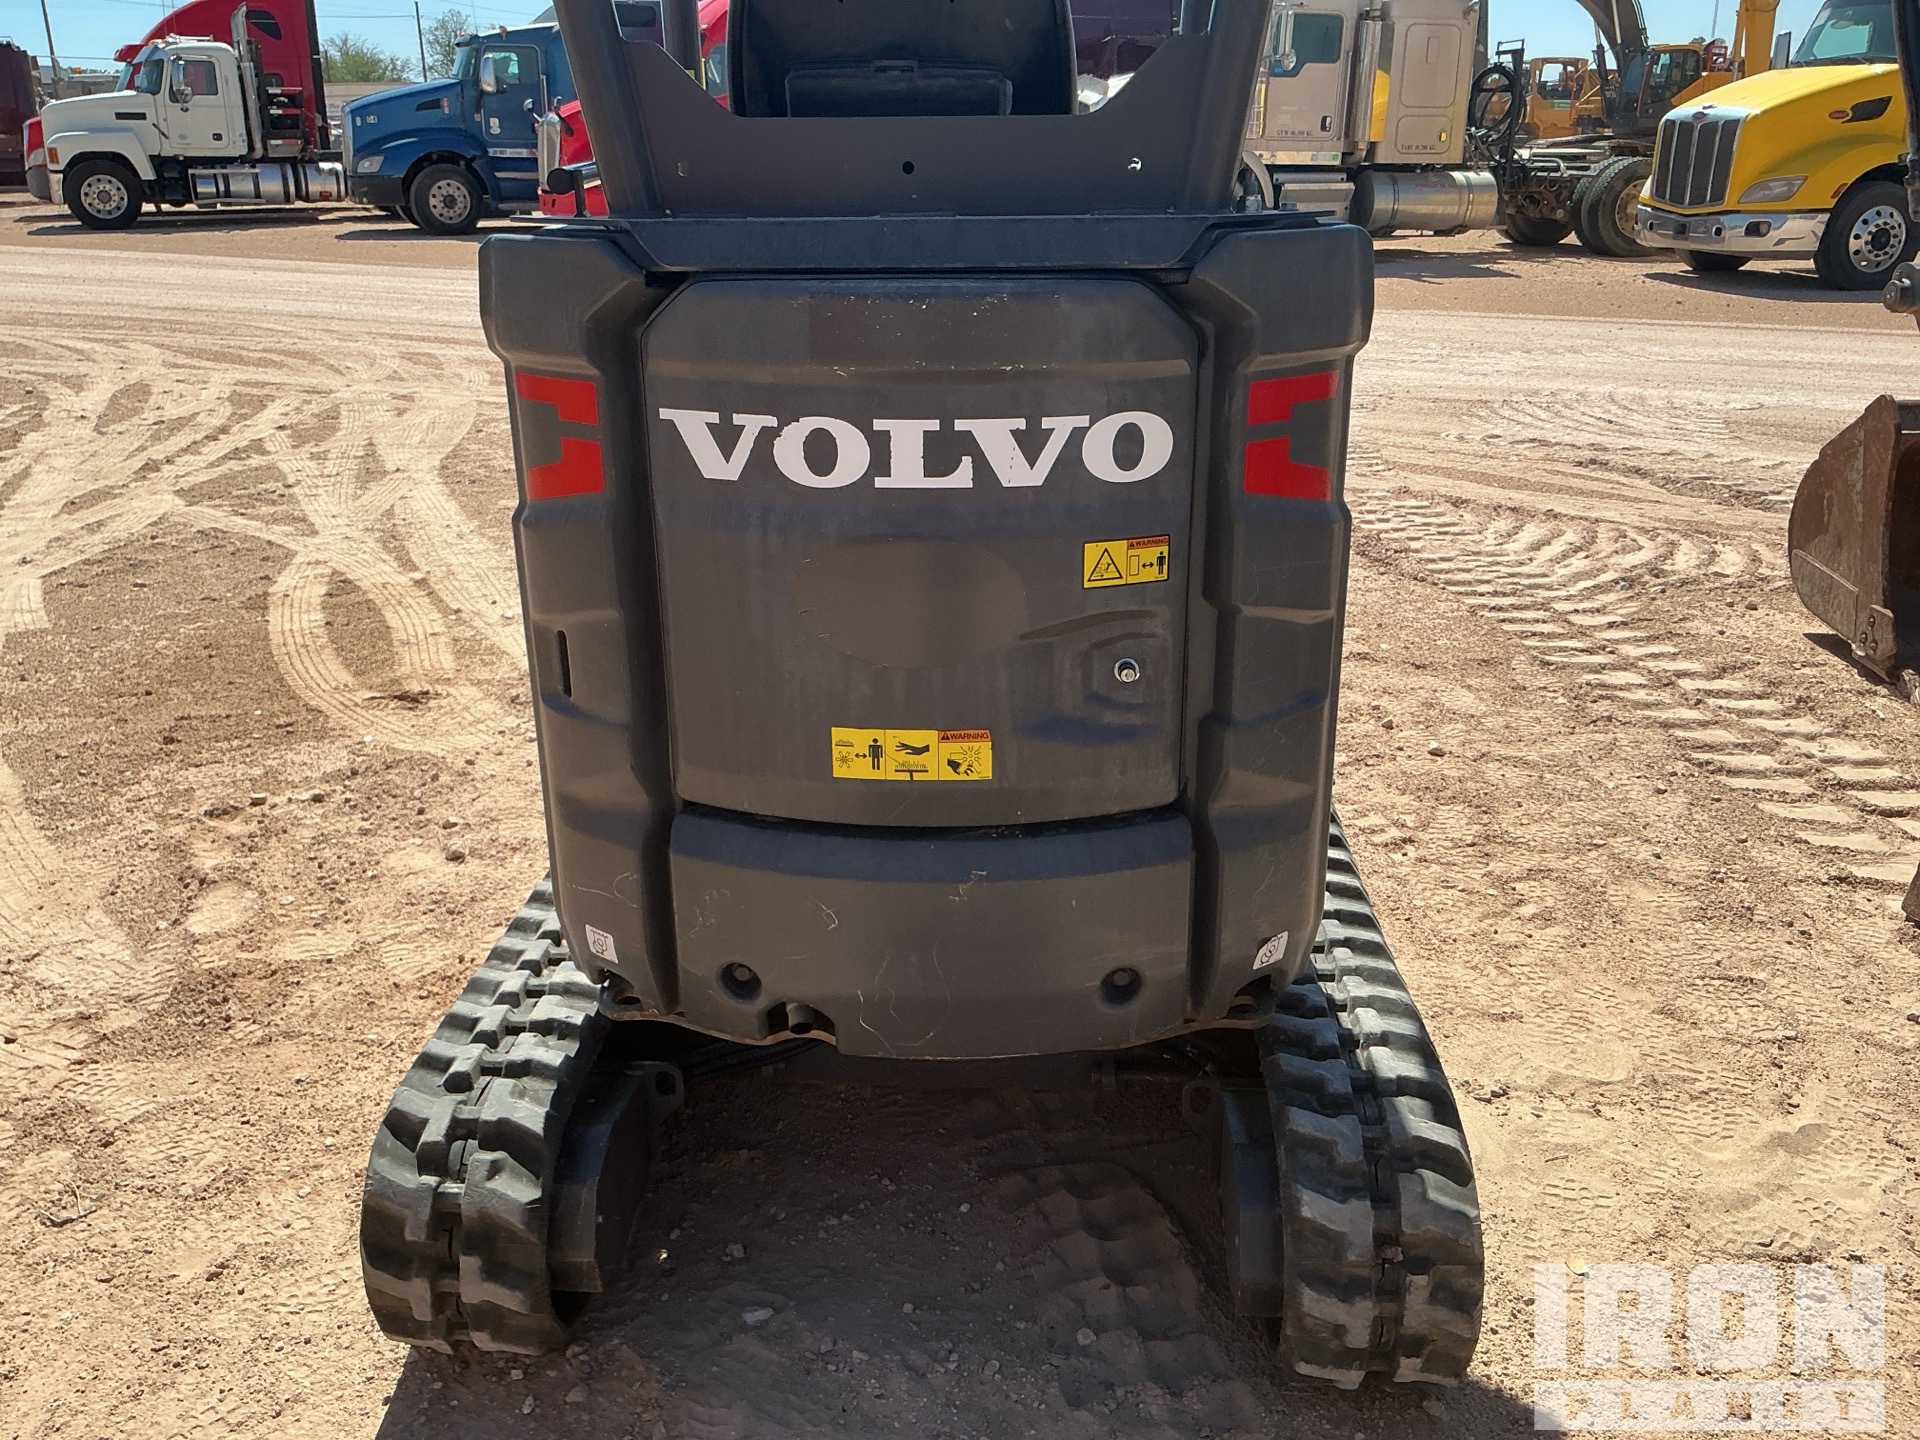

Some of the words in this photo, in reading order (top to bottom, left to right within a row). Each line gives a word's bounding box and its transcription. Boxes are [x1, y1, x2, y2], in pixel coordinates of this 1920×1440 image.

[659, 408, 1174, 488] VOLVO
[1136, 537, 1168, 547] WARNING
[949, 731, 989, 741] WARNING
